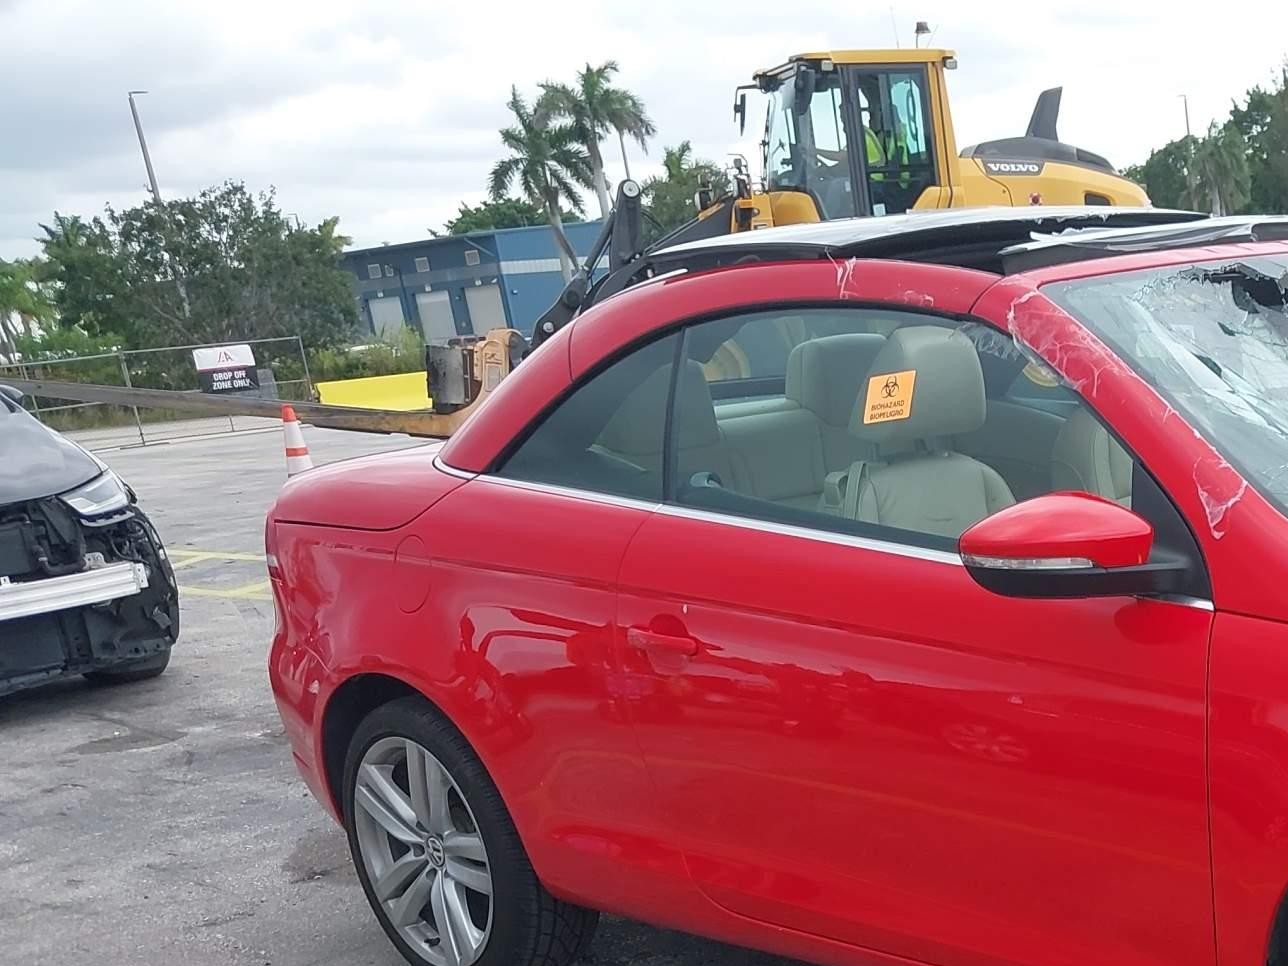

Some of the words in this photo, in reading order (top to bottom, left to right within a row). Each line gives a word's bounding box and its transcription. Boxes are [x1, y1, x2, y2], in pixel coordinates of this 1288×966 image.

[987, 163, 1039, 172] VOLVO
[213, 371, 233, 381] DROP
[234, 370, 246, 379] OFF
[212, 381, 233, 391] ZONE
[233, 378, 251, 388] ONLY
[871, 400, 904, 411] BIOHAZARD
[870, 409, 904, 420] BIOPELIGRO
